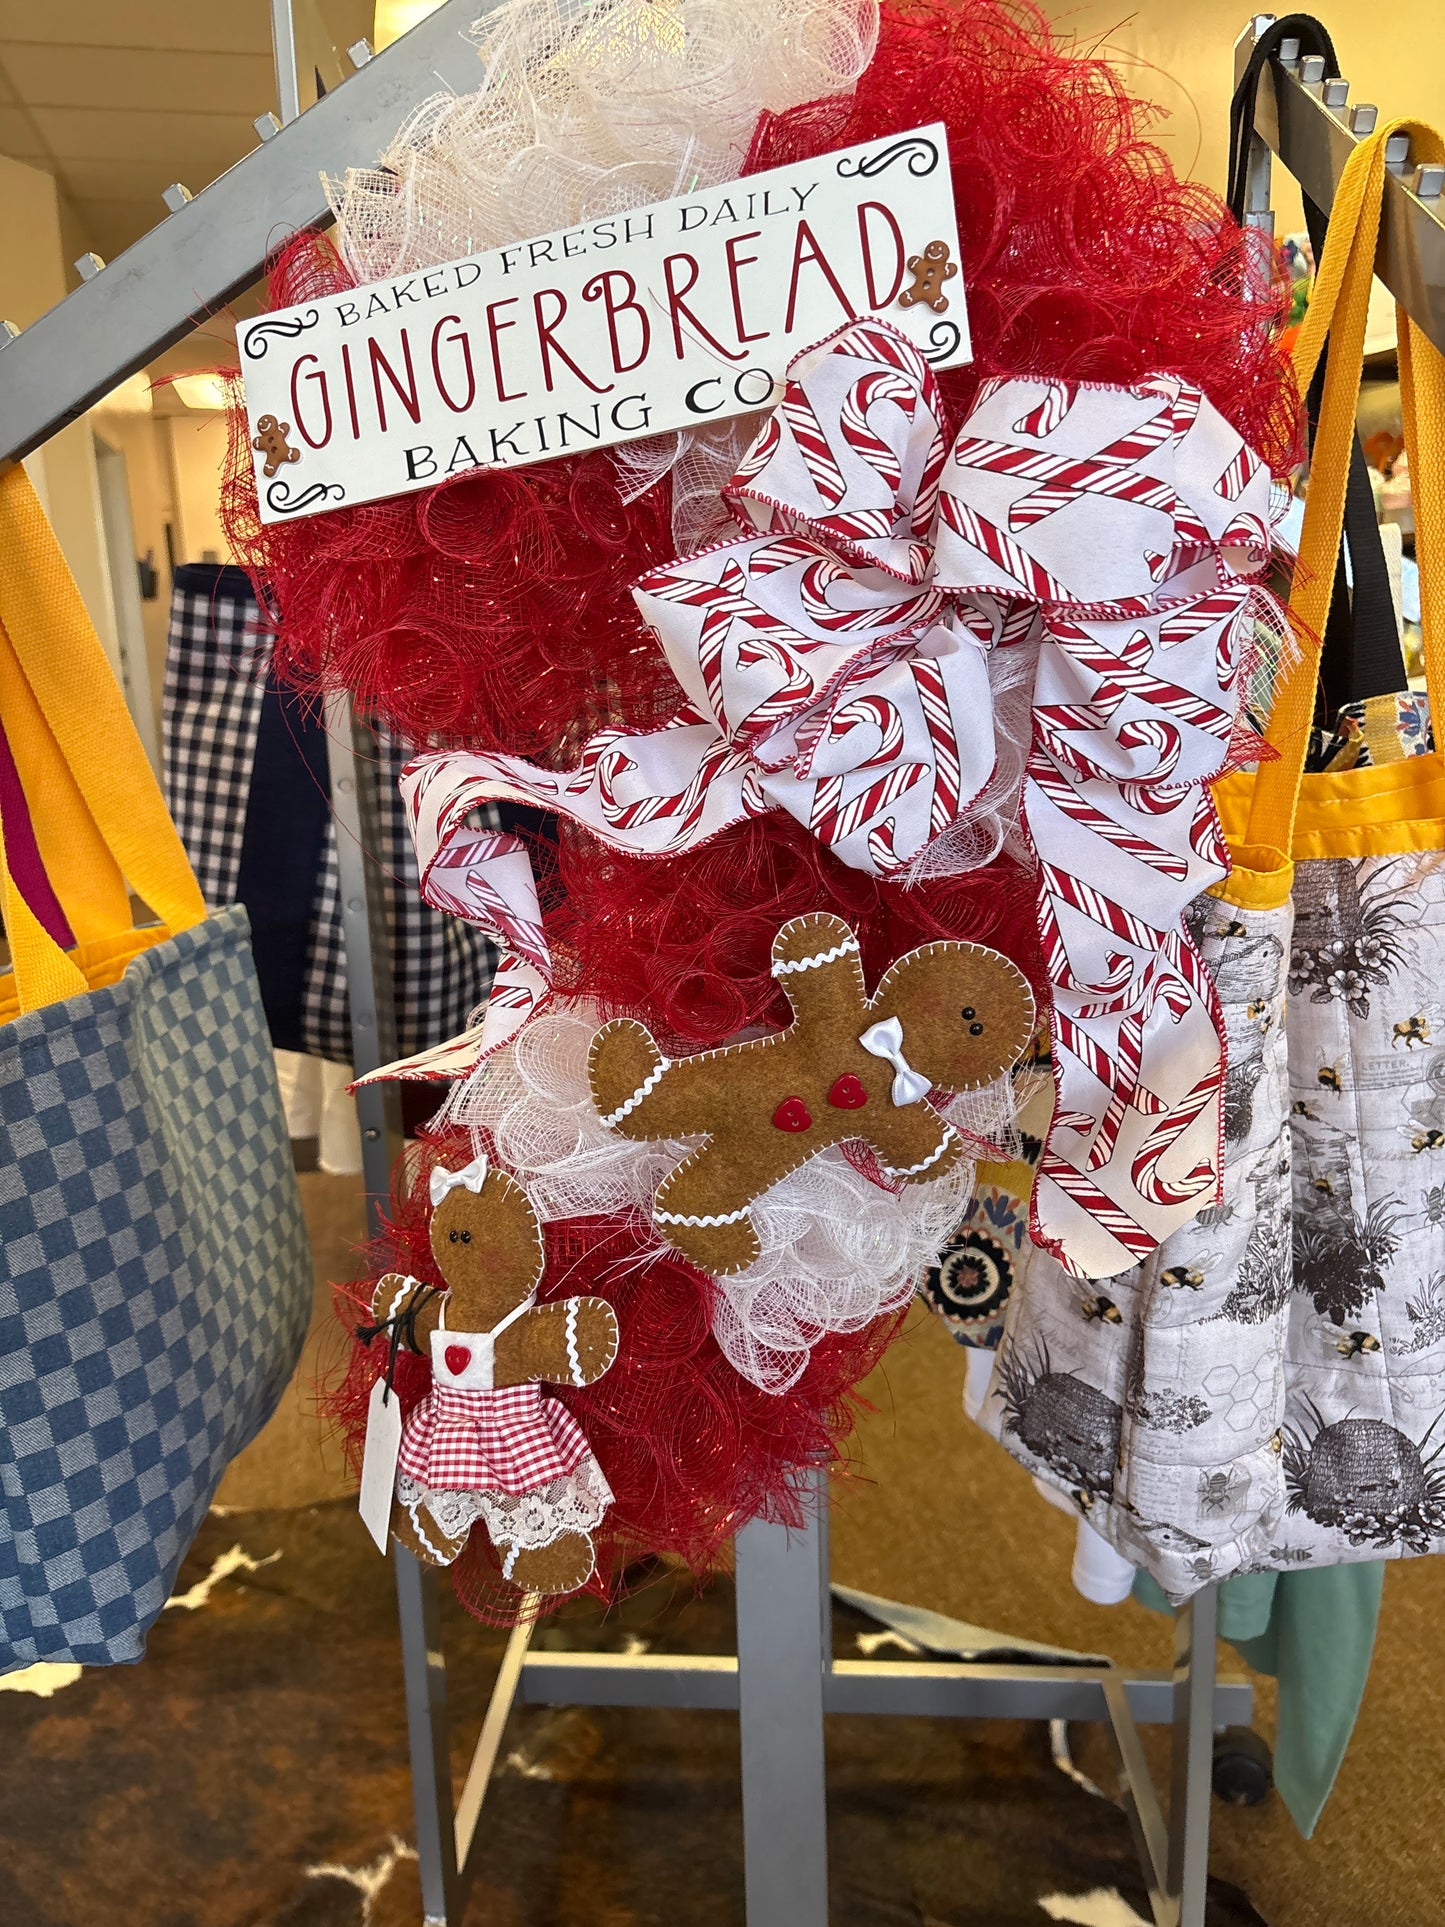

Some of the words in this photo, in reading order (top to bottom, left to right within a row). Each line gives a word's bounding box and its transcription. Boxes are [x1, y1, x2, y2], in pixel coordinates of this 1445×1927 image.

[290, 201, 908, 449] GINGERBREAD
[336, 263, 480, 328] BAKED
[500, 213, 654, 276] FRESH
[680, 182, 819, 232] DAILY
[404, 392, 652, 482] BAKING
[684, 367, 775, 414] CO
